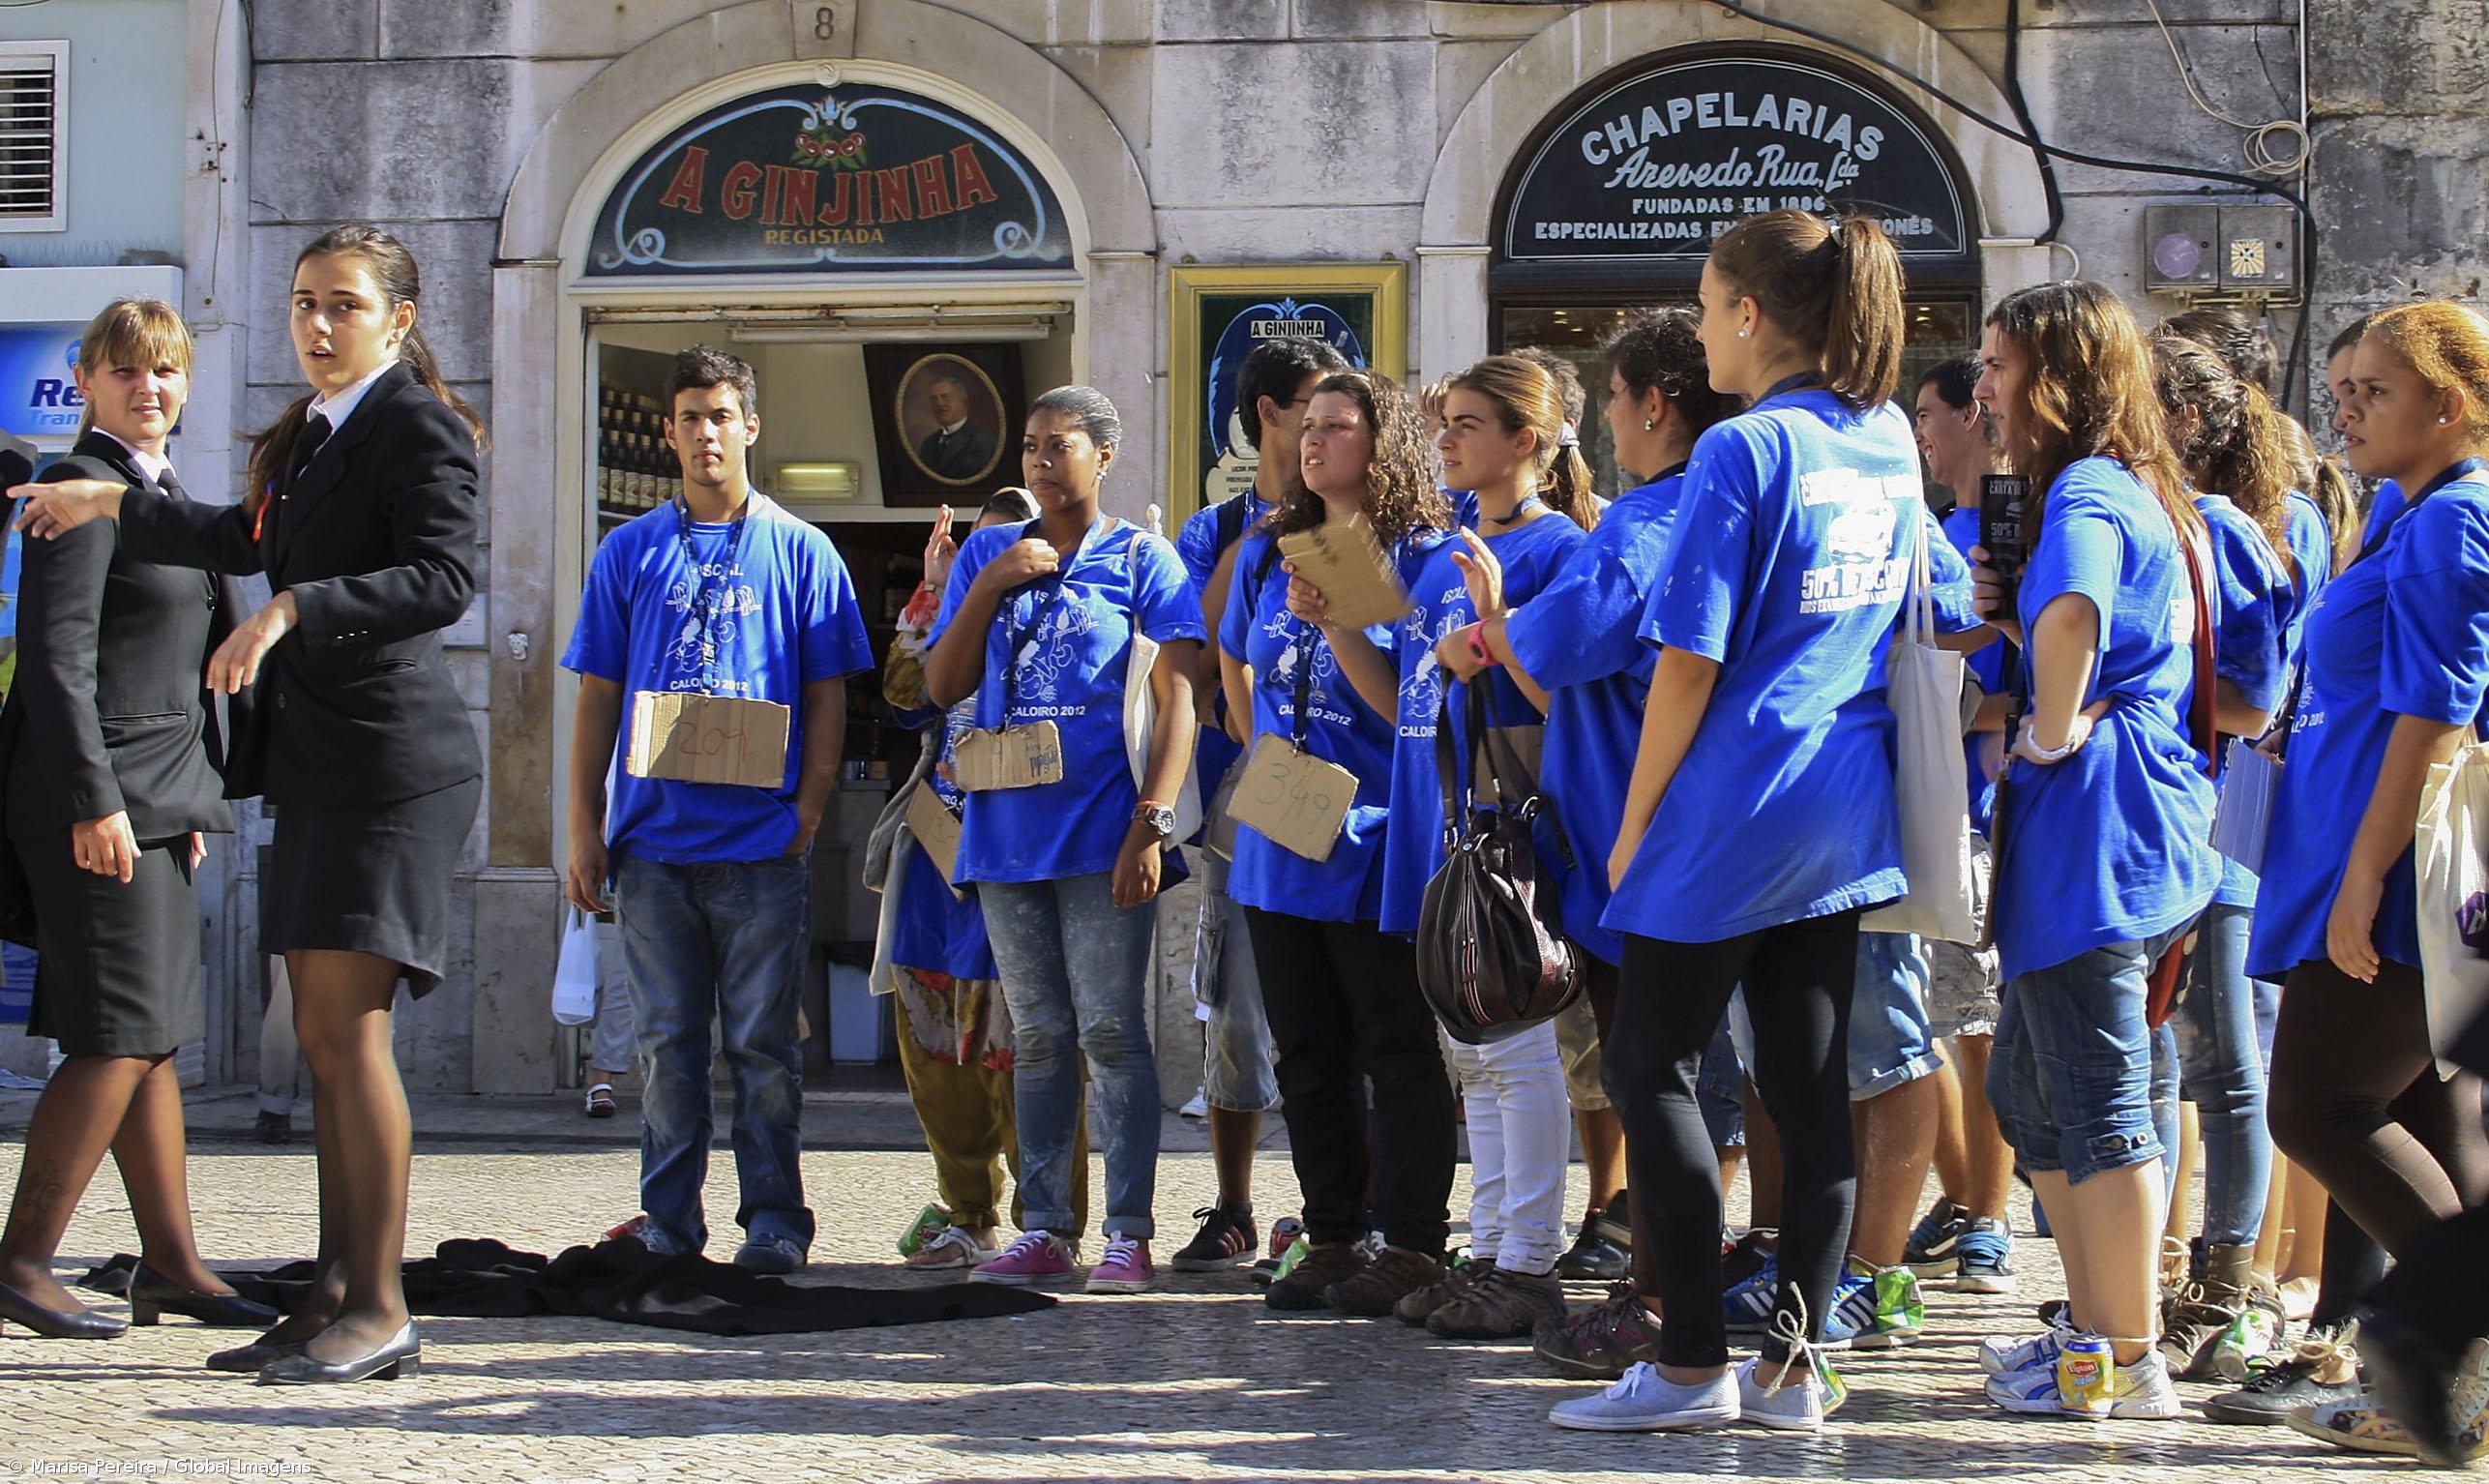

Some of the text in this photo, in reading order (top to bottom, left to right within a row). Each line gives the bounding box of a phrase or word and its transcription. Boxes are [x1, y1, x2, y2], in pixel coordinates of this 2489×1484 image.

[815, 7, 834, 40] 8
[1581, 92, 1884, 165] CHAPELARIAS
[1604, 146, 1753, 189] Azevedo
[659, 142, 998, 227] A GINJINHA
[1632, 195, 1825, 215] FUNDADAS EM 1886
[764, 228, 884, 244] REGISTADA
[1534, 222, 1703, 240] ESPECIALIZADAS
[1252, 321, 1260, 337] A
[29, 378, 86, 407] Re
[30, 408, 80, 426] Tran
[1059, 705, 1085, 716] 2012
[1278, 703, 1352, 726] CALRO 2012
[679, 721, 747, 764] 209
[1399, 726, 1437, 738] CALOIR
